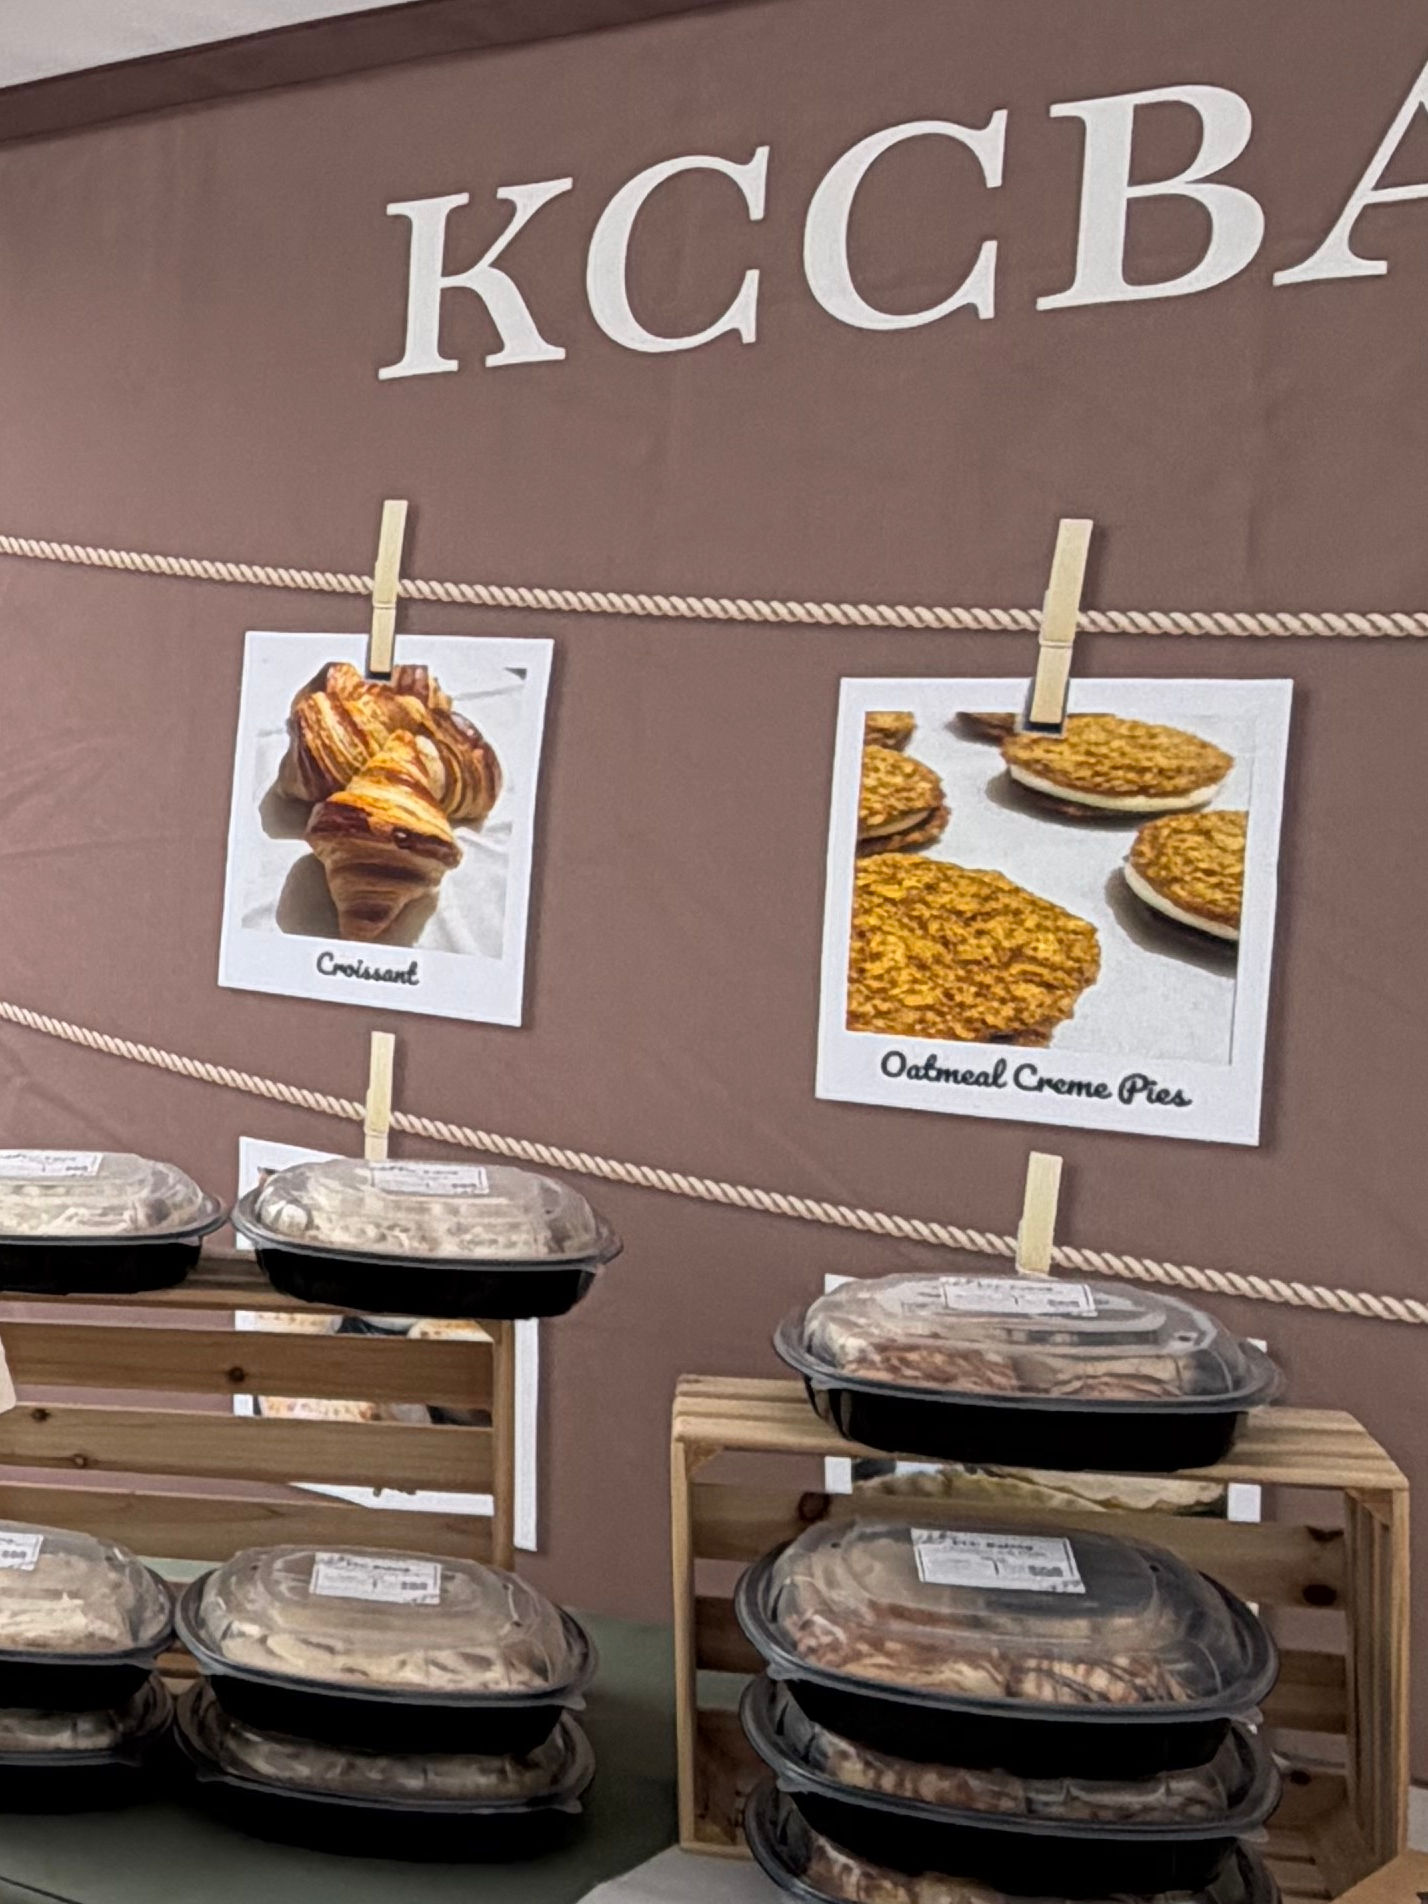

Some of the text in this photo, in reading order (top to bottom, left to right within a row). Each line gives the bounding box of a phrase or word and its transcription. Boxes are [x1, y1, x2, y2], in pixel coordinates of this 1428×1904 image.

[316, 951, 419, 985] Croissant
[880, 1049, 1193, 1108] Oatmeal Creme Pies
